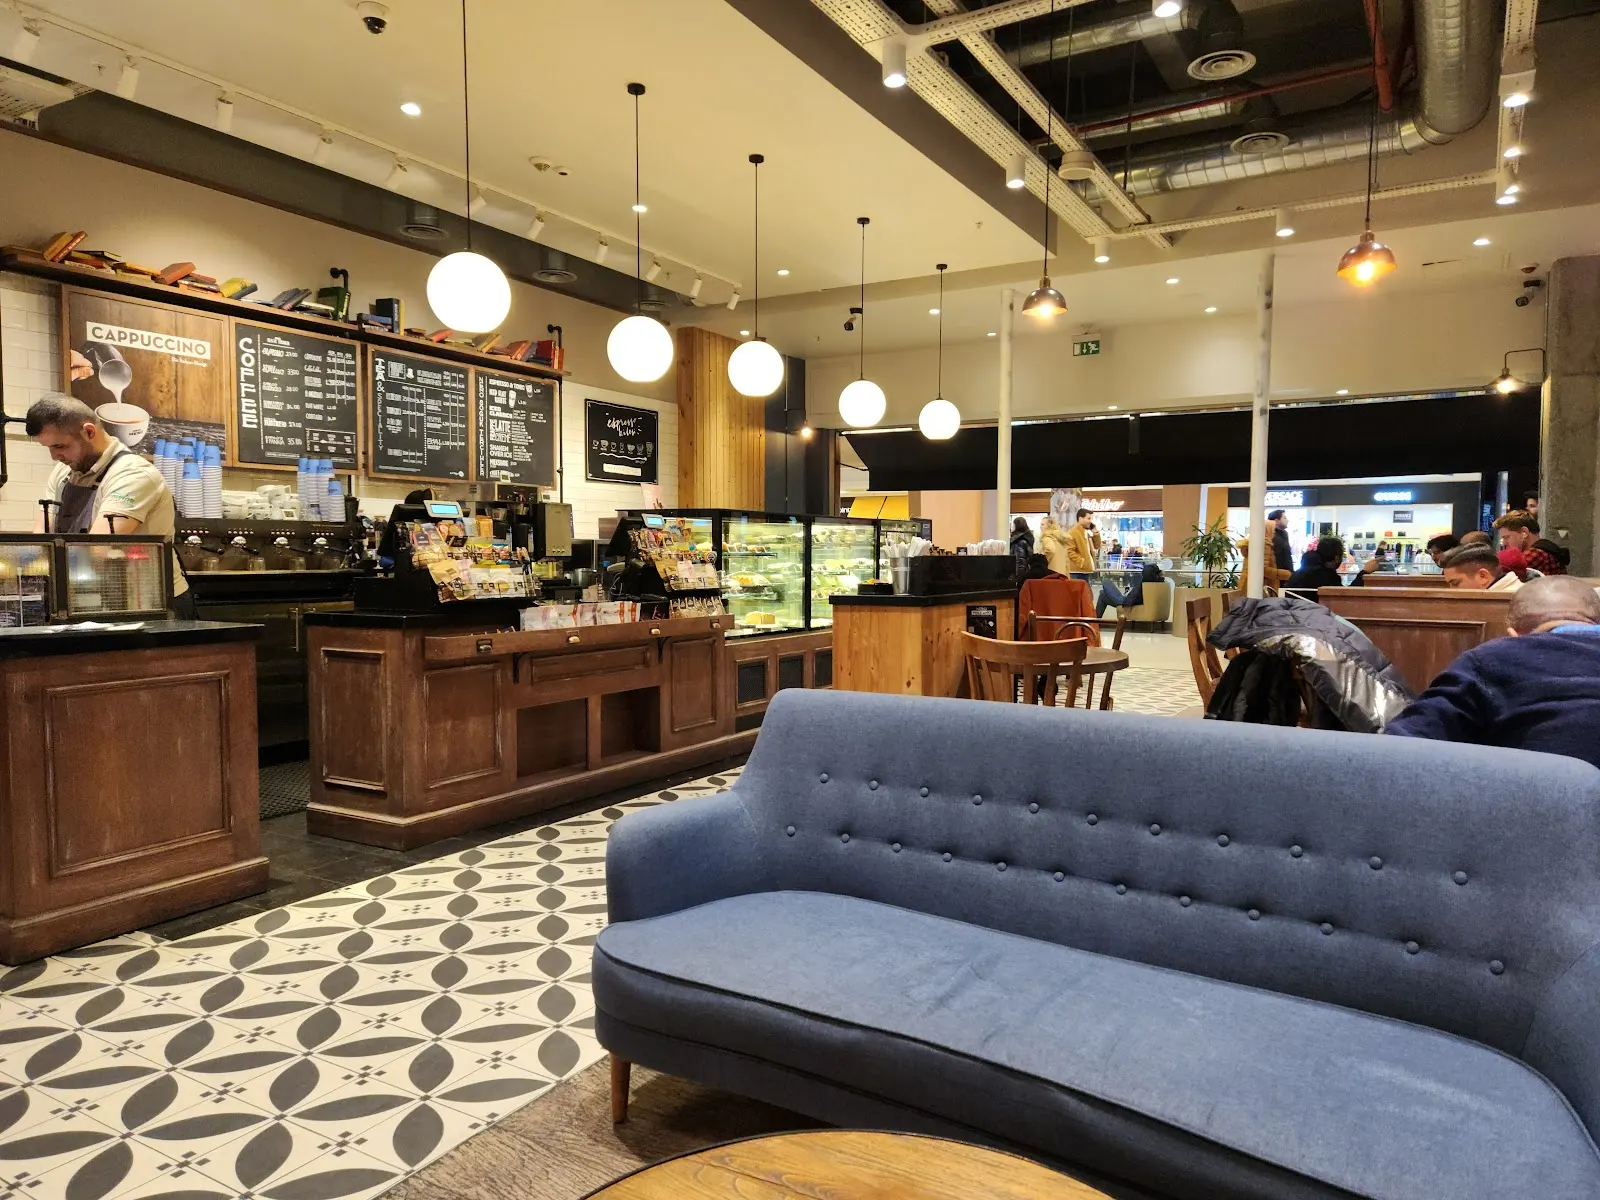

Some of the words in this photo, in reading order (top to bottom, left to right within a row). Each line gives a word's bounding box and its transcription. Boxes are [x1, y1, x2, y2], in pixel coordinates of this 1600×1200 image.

[91, 326, 207, 356] CAPPUCCINO
[239, 337, 258, 428] COFFEE
[375, 358, 385, 381] TEA
[376, 381, 385, 393] &
